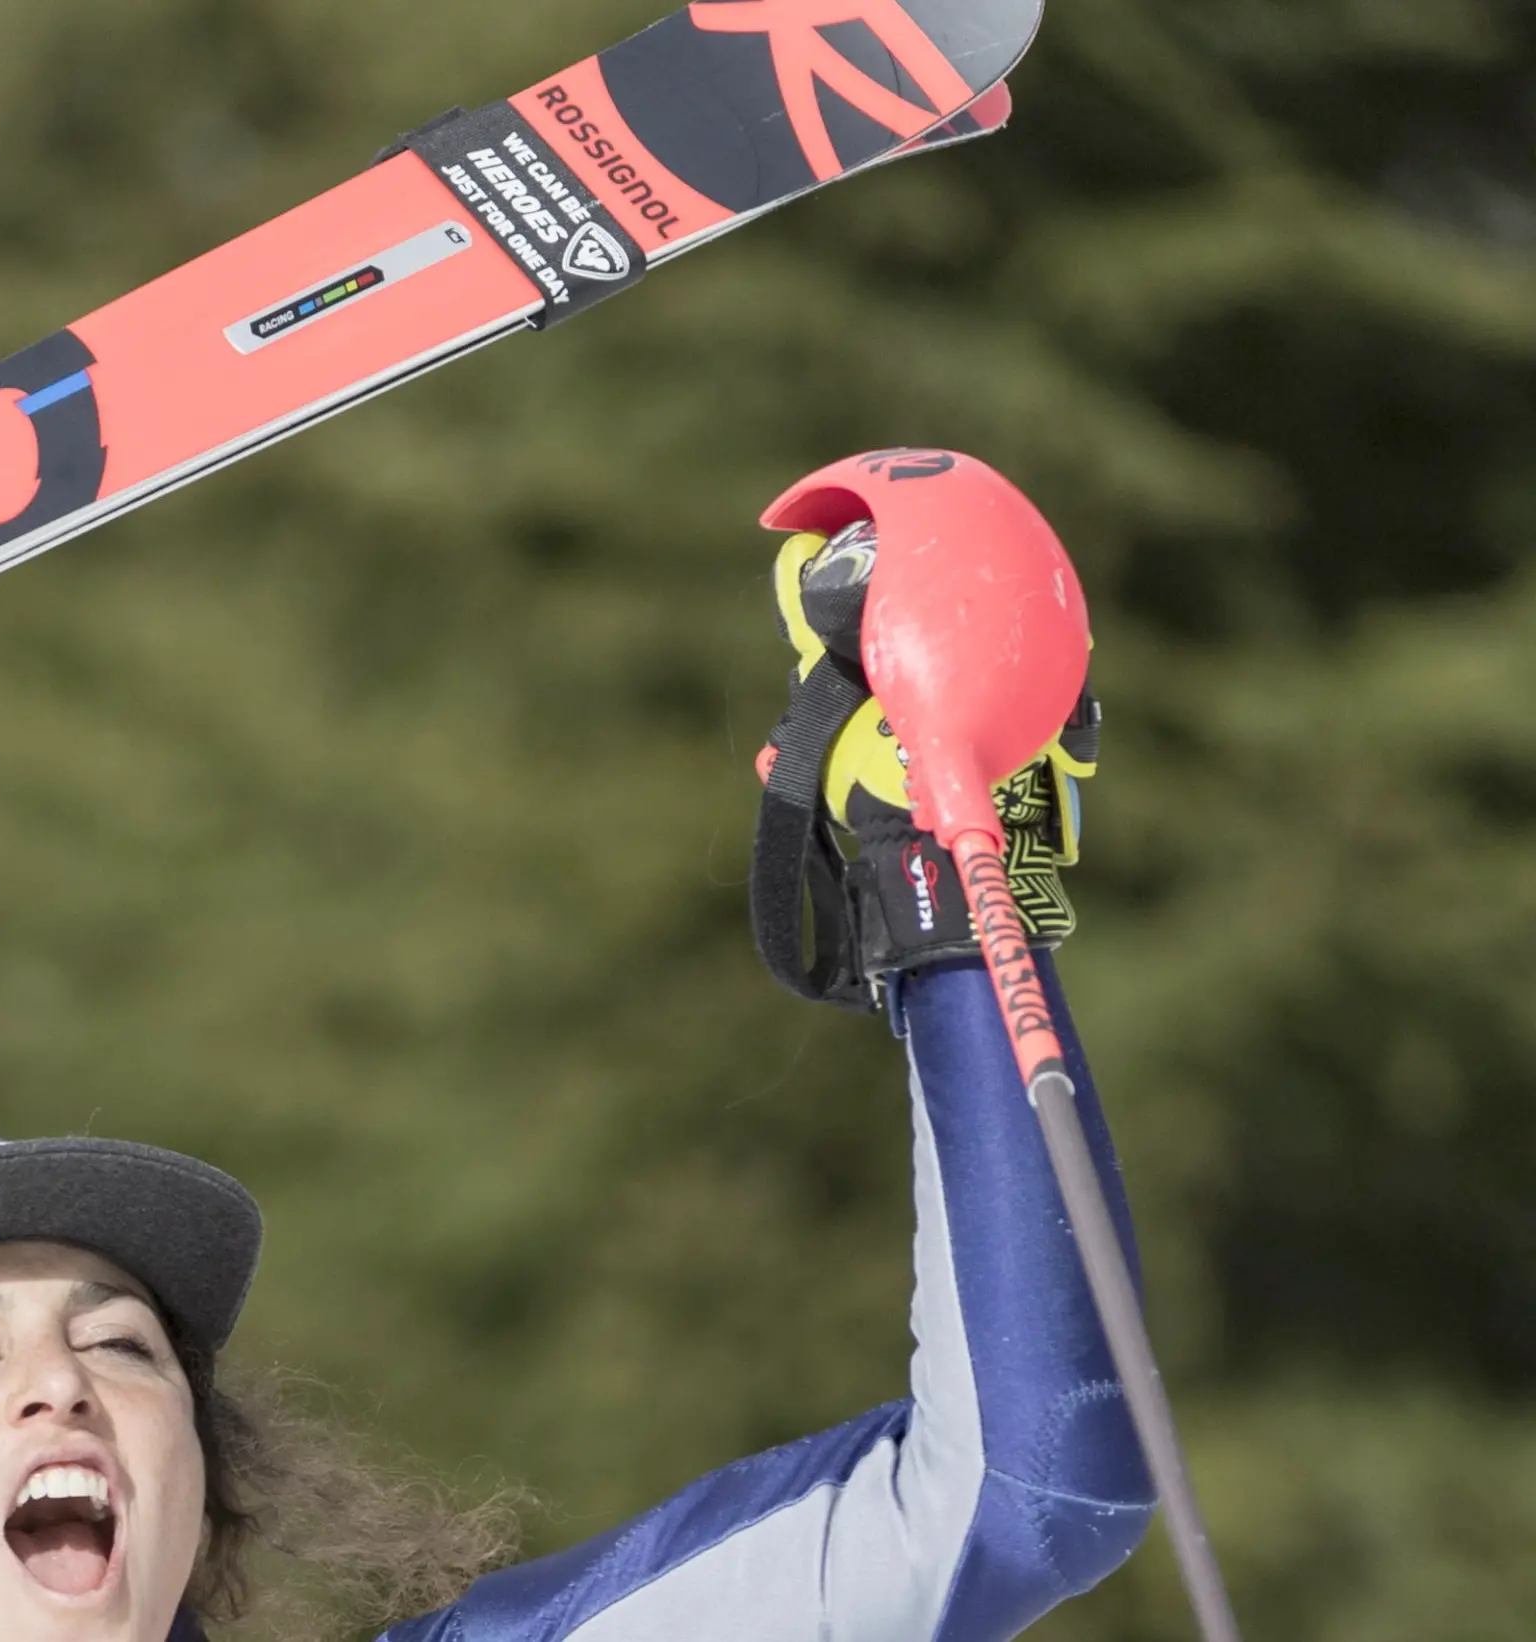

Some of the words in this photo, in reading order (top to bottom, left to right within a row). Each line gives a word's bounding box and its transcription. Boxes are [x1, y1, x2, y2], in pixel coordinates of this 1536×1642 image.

[466, 148, 569, 243] HEROES
[502, 131, 538, 166] WE
[527, 161, 570, 201] CAN
[558, 195, 592, 225] BE
[536, 84, 680, 240] ROSSIGNOL
[441, 164, 488, 203] JUST
[477, 199, 516, 238] FOR
[507, 233, 547, 271] ONE
[536, 266, 570, 304] DAY
[259, 310, 295, 335] RACING
